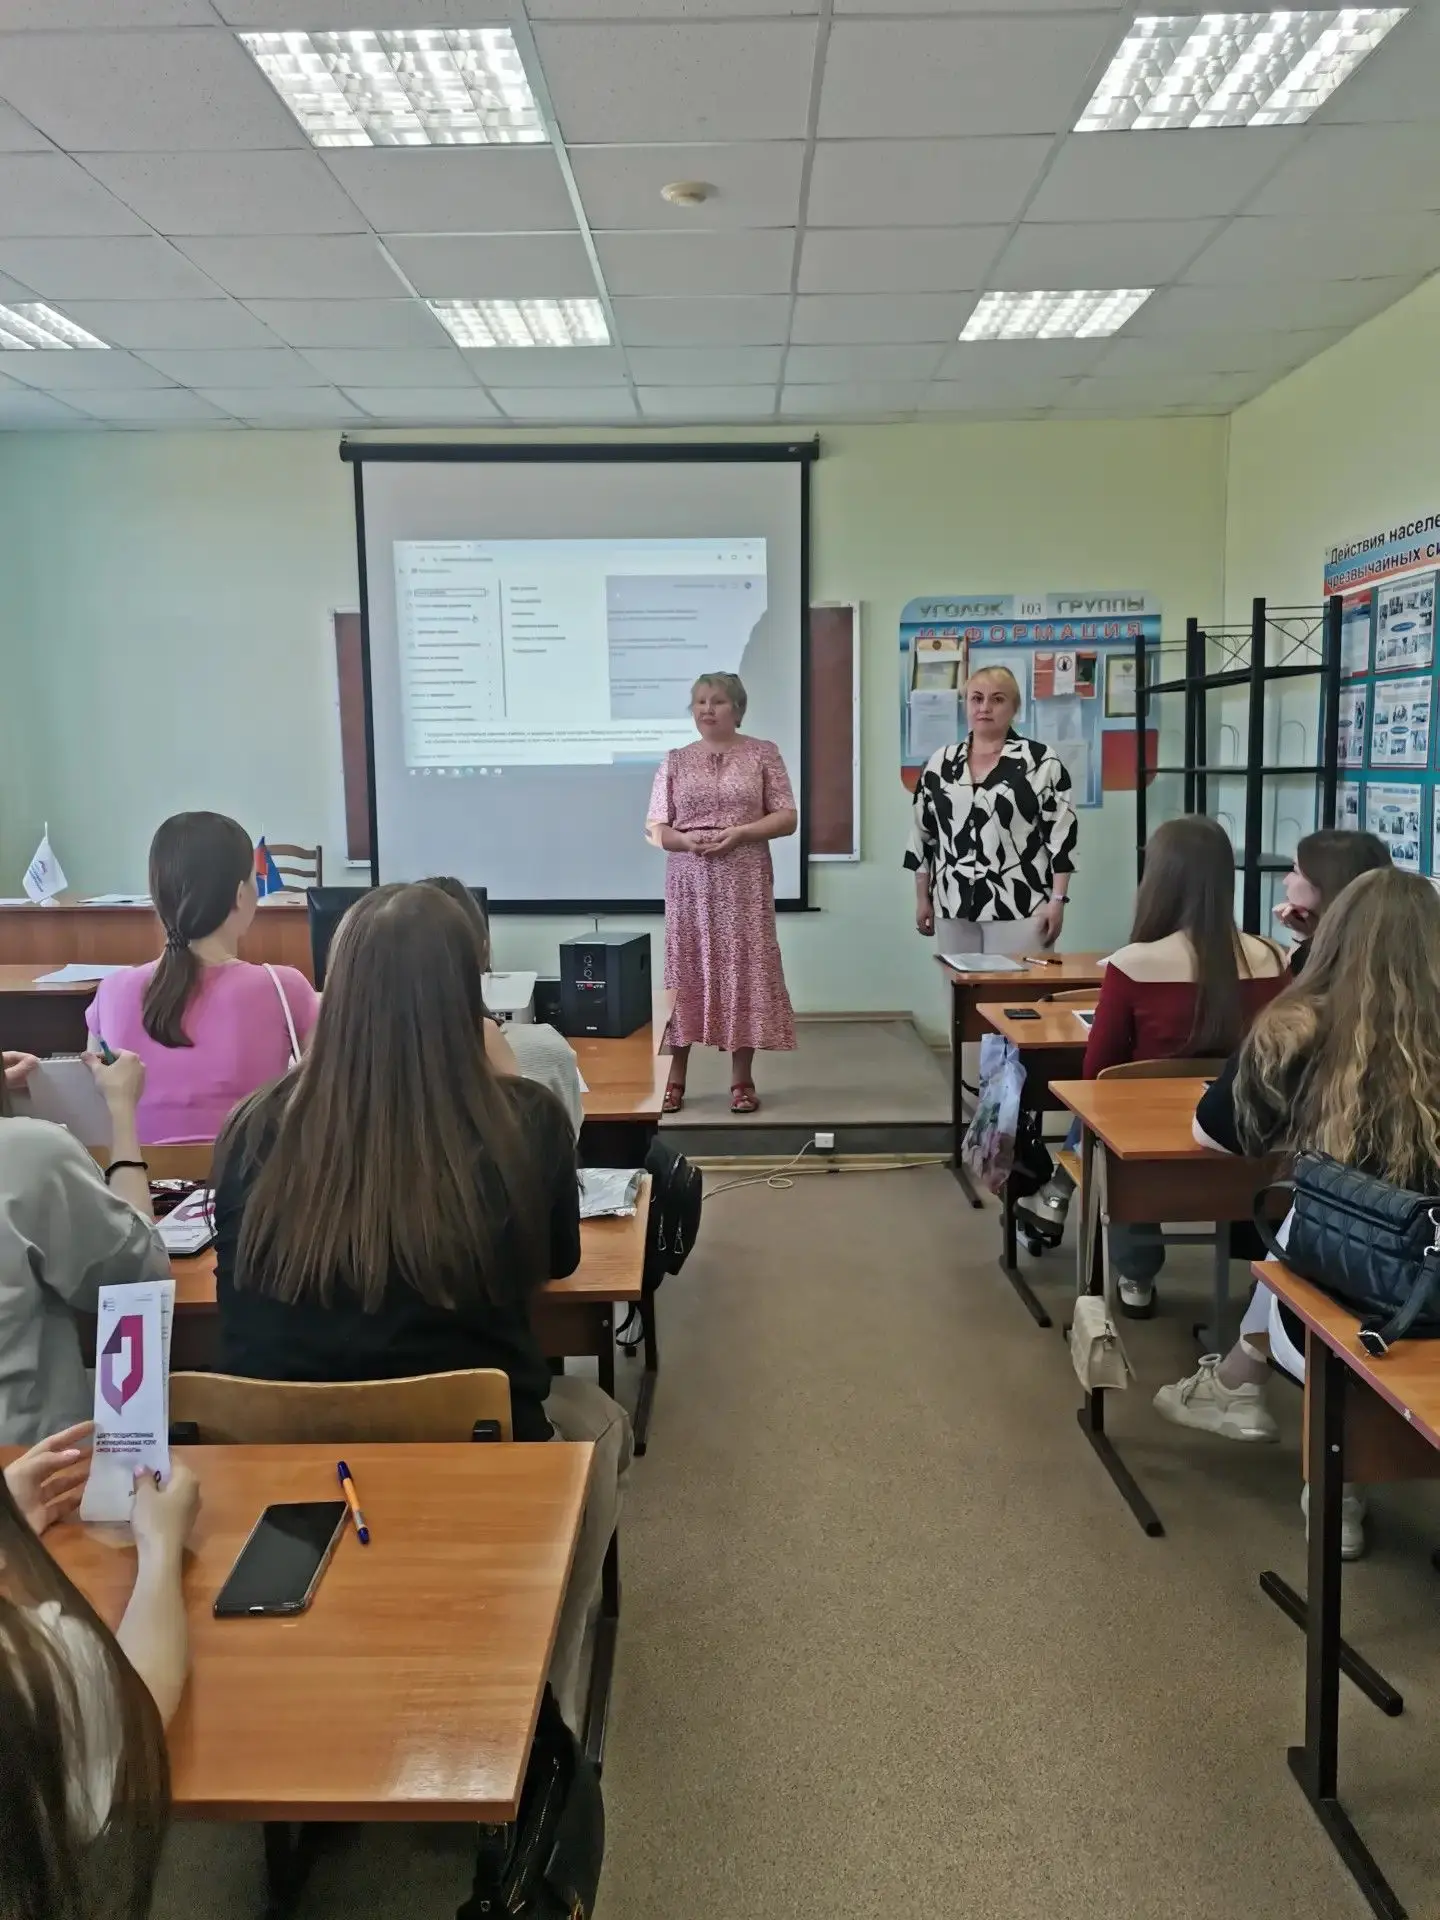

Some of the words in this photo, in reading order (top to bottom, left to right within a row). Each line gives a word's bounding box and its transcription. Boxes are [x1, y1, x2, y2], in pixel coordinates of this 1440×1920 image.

[1330, 533, 1385, 565] Действия
[1327, 547, 1421, 588] чрезвычайных
[920, 601, 1004, 618] УГОЛОК
[1021, 602, 1041, 615] 103
[1057, 597, 1144, 614] ГРУППЫ
